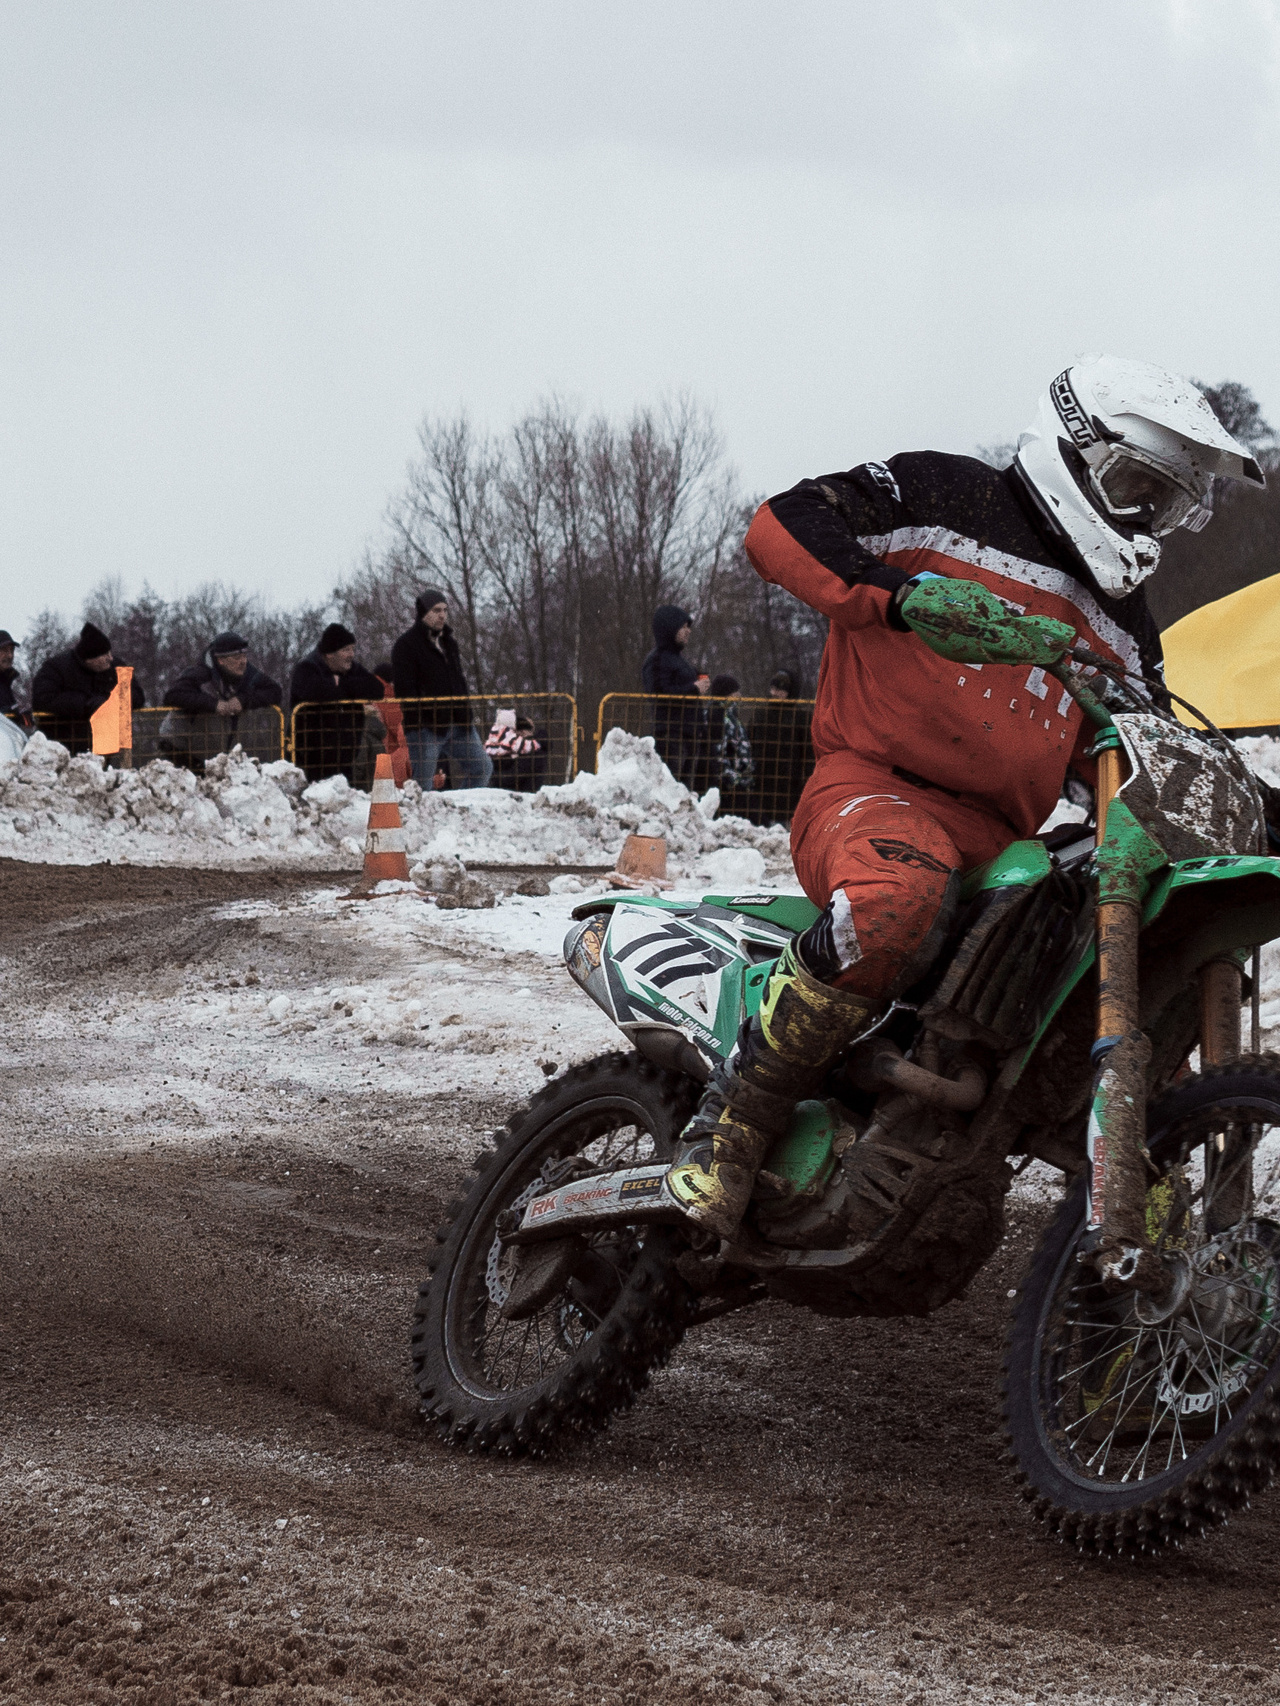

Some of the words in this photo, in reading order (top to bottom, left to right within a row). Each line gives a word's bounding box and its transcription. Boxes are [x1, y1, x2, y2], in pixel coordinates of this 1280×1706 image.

[1053, 370, 1098, 442] SCOTT
[957, 676, 1066, 739] RACING
[657, 1001, 723, 1049] moto-falcon.ru
[563, 1187, 613, 1205] BRAKING
[621, 1178, 661, 1192] EXCEL
[1091, 1136, 1108, 1224] BRAKING
[530, 1194, 559, 1218] RK
